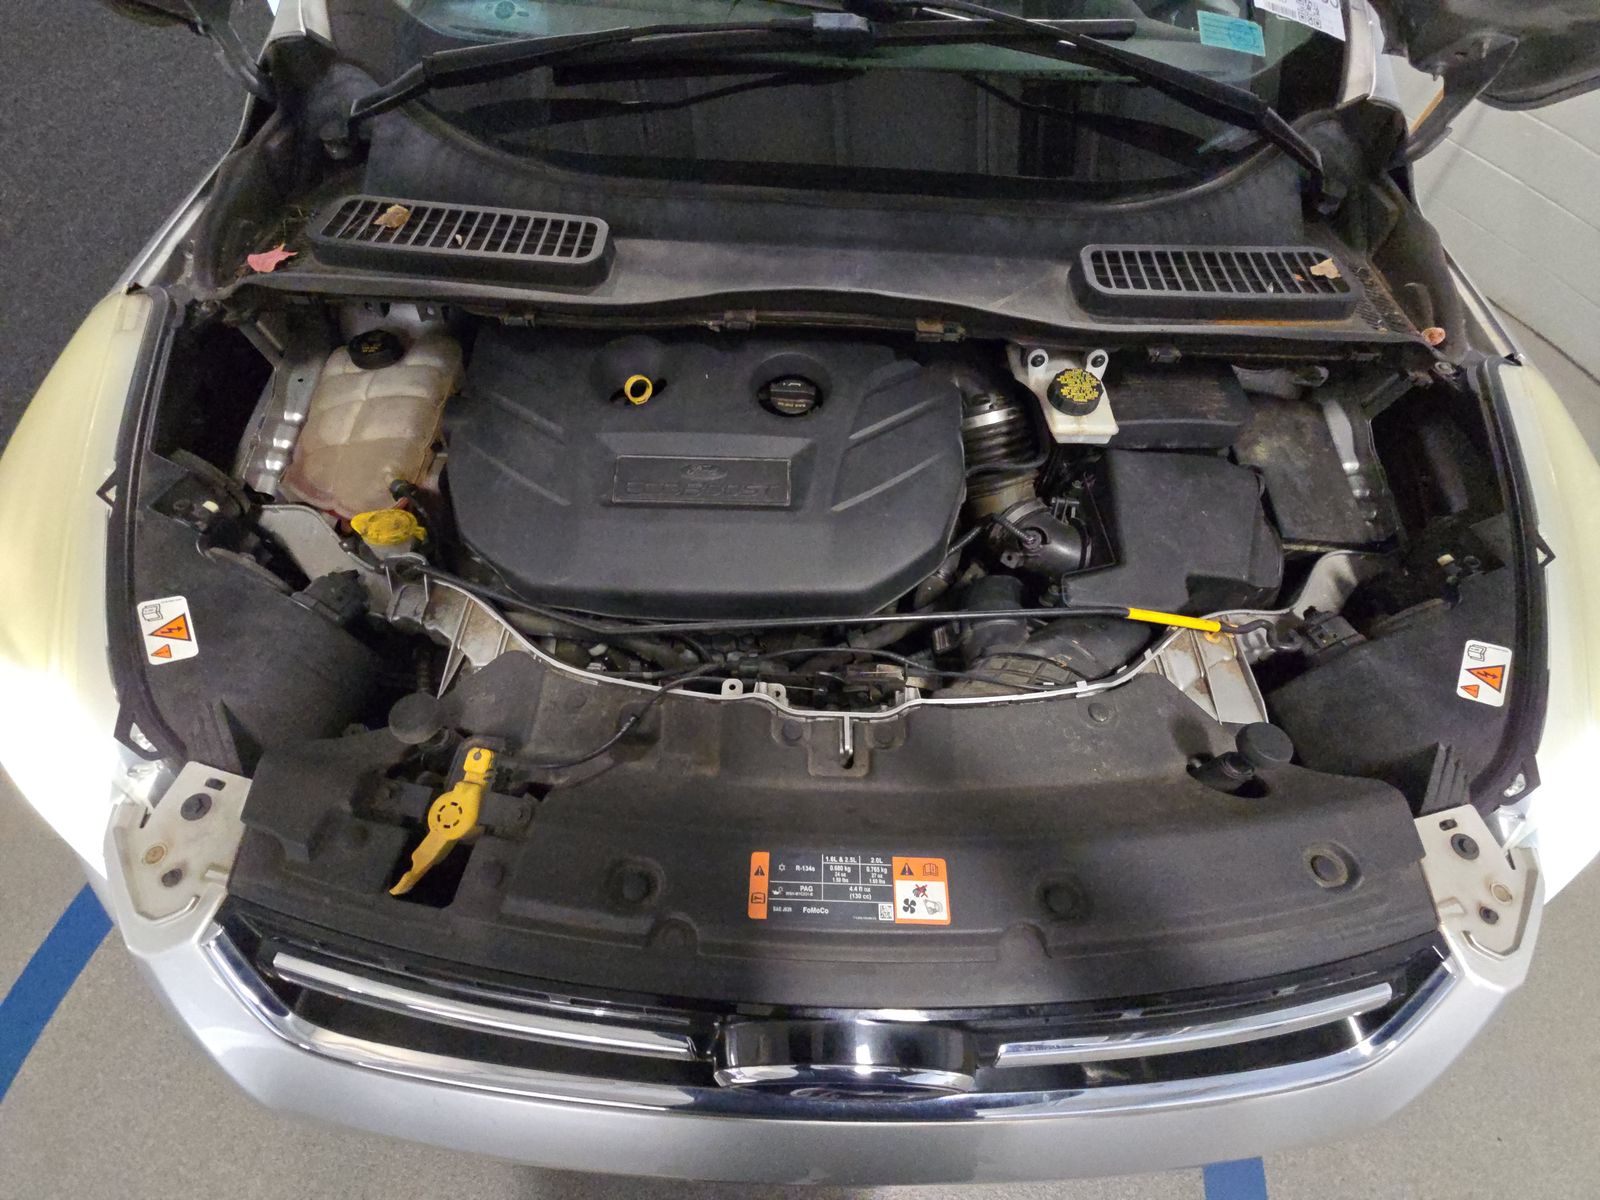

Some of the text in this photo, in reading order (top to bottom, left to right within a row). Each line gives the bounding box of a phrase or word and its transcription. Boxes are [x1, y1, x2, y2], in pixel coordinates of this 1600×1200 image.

[795, 864, 816, 872] R-134a
[844, 865, 851, 873] kg
[880, 866, 888, 874] kg
[802, 906, 829, 914] FoMoCo
